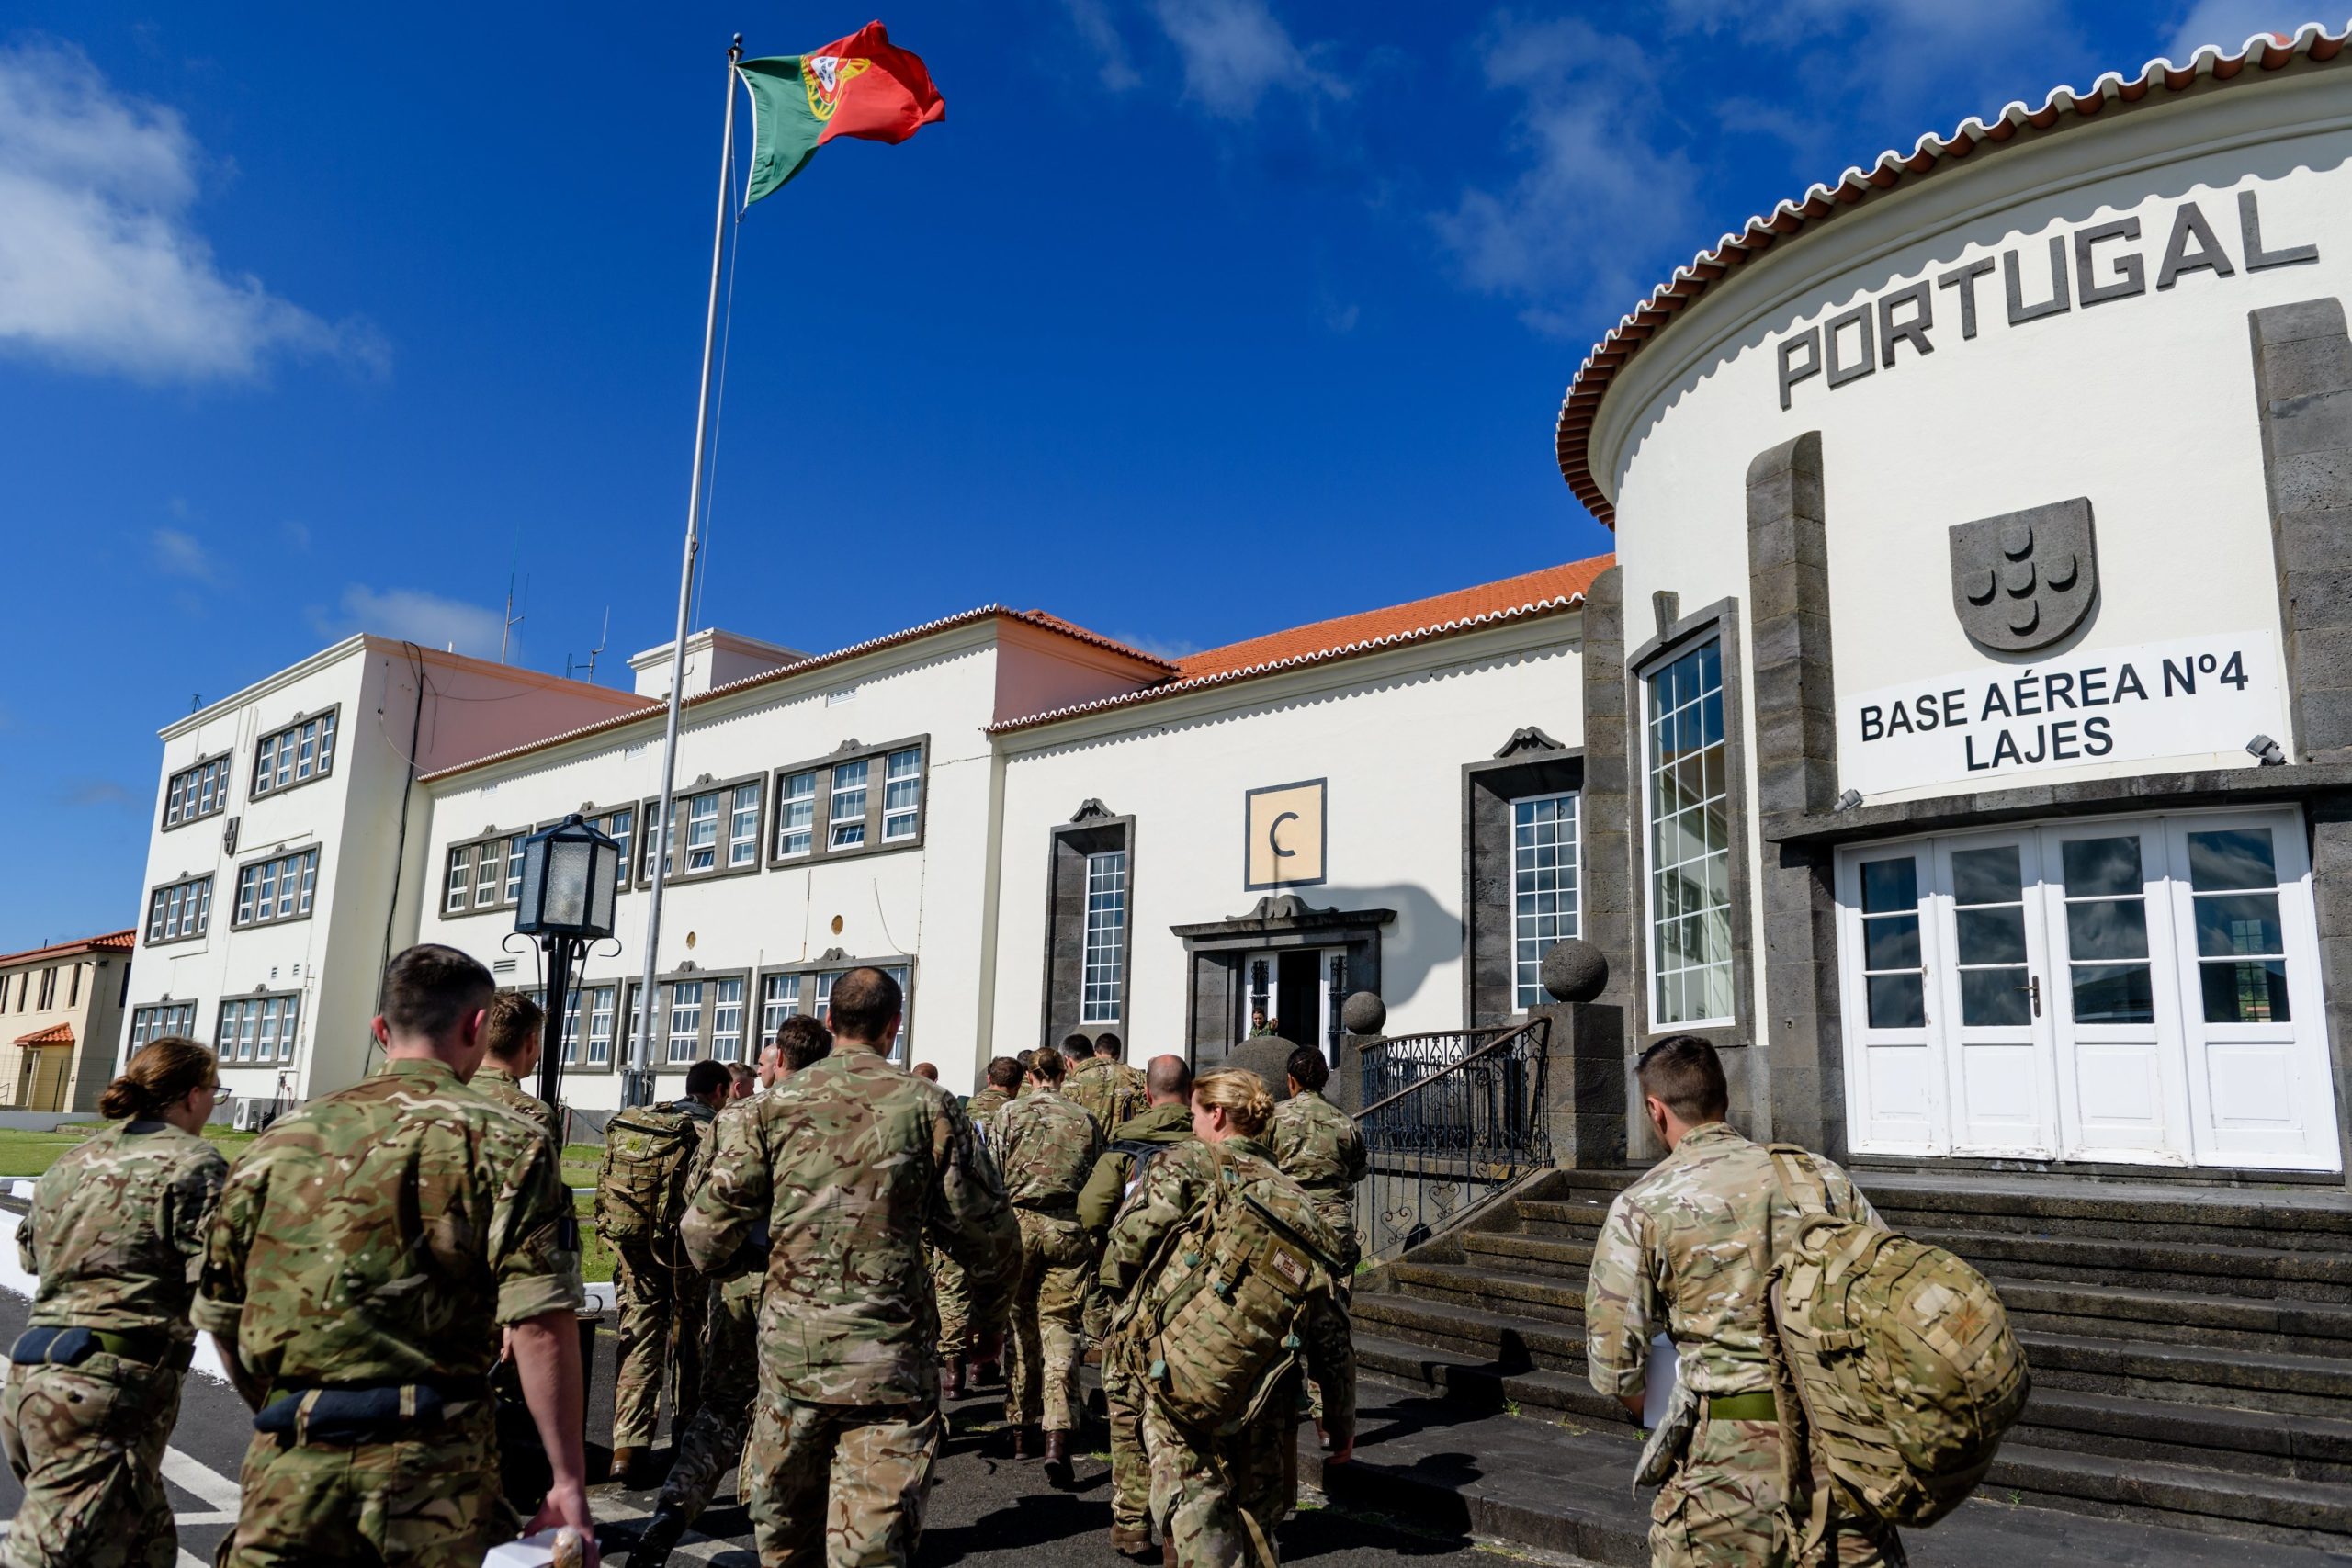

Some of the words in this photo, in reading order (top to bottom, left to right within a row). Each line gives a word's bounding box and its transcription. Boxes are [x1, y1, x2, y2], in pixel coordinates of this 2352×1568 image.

[1778, 190, 2318, 411] PORTUGAL
[1860, 688, 1968, 742] BASE
[1980, 663, 2149, 722] AÉREA
[1965, 716, 2113, 772] LAJES
[1270, 812, 1298, 857] C
